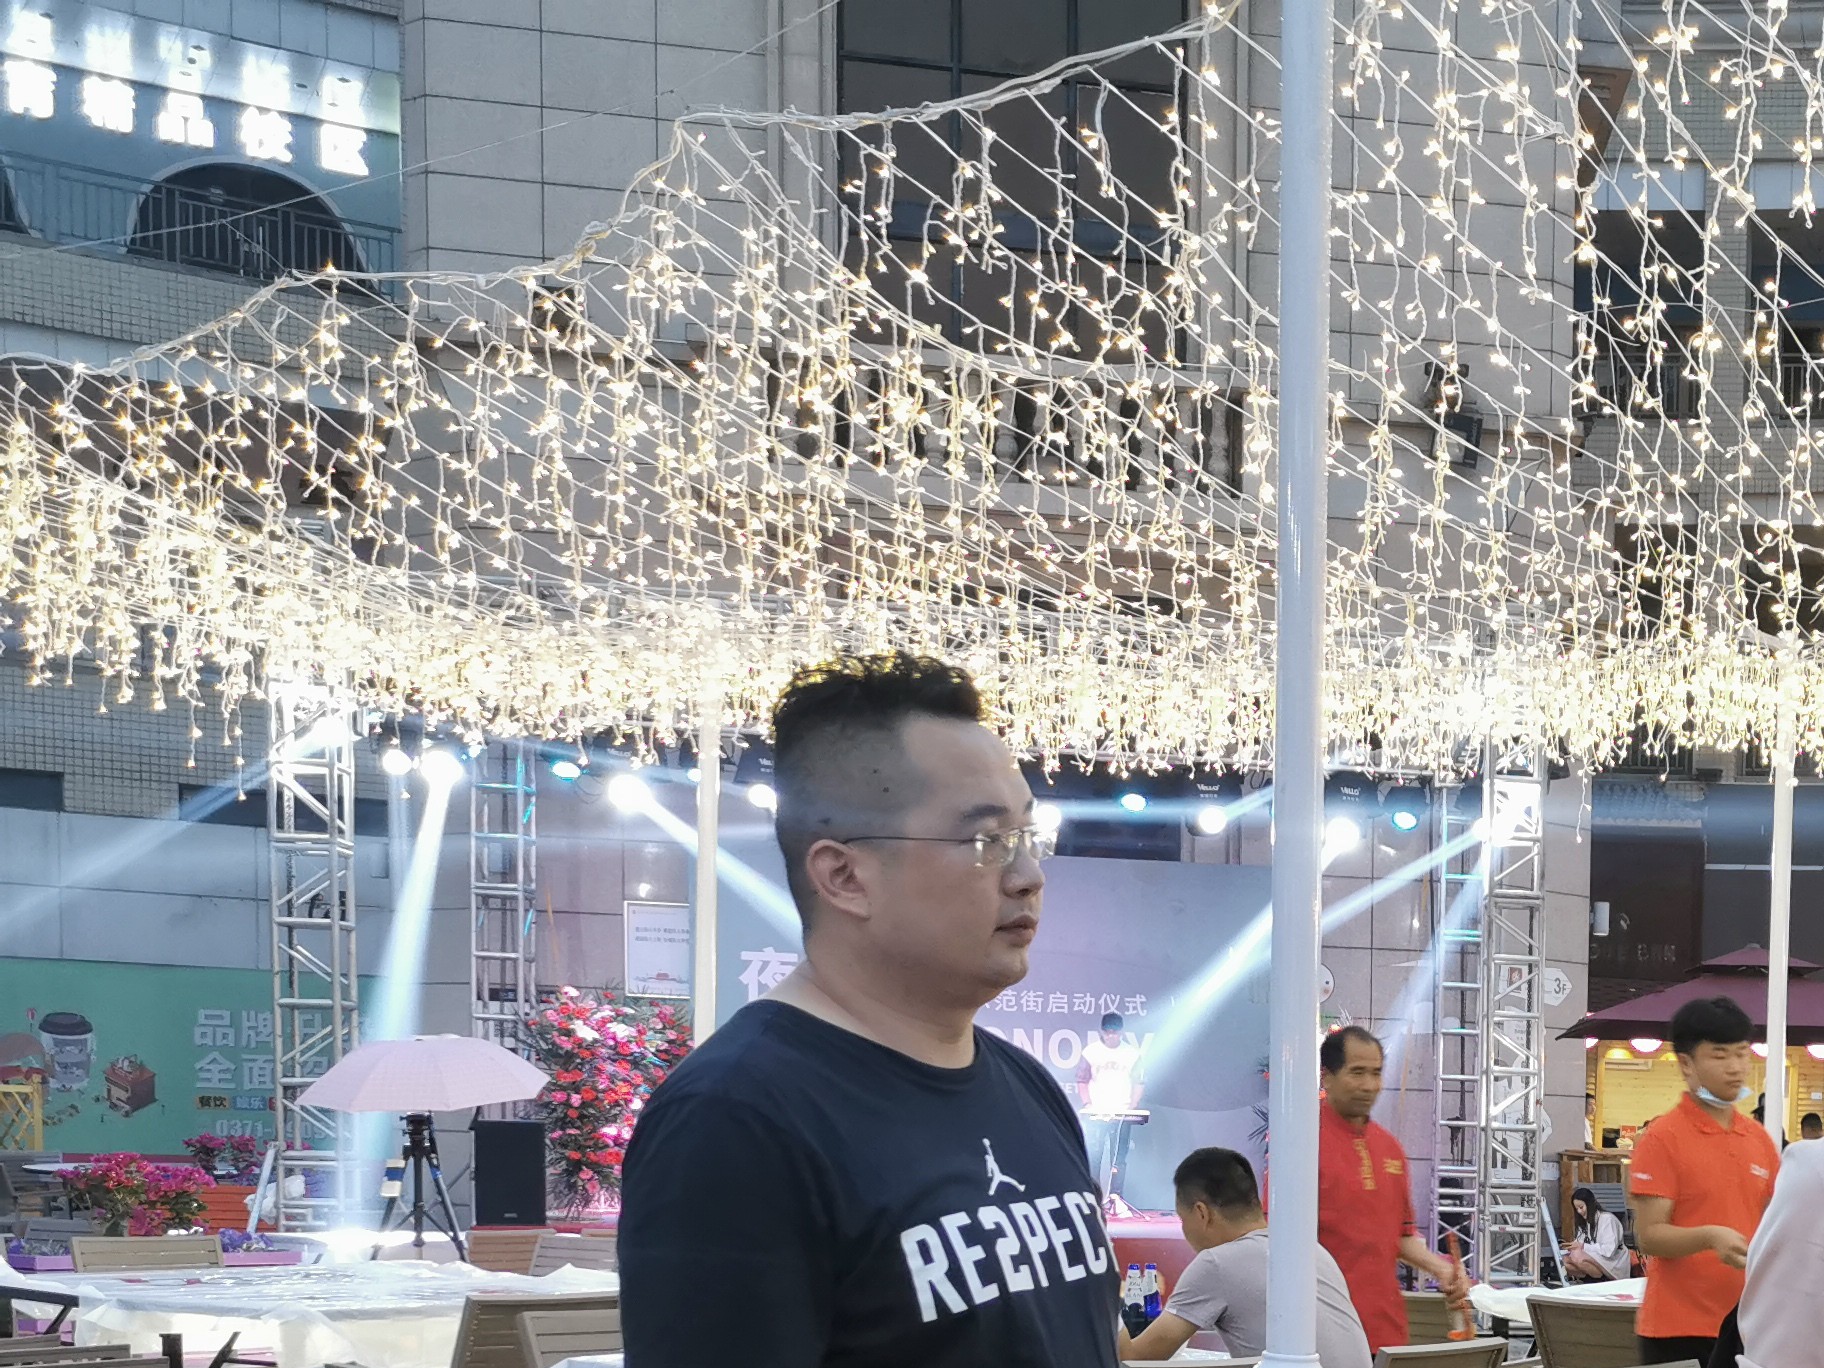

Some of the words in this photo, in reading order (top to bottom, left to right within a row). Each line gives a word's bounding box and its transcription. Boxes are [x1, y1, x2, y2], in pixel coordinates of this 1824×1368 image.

[984, 988, 1148, 1017] 范街启动仪式
